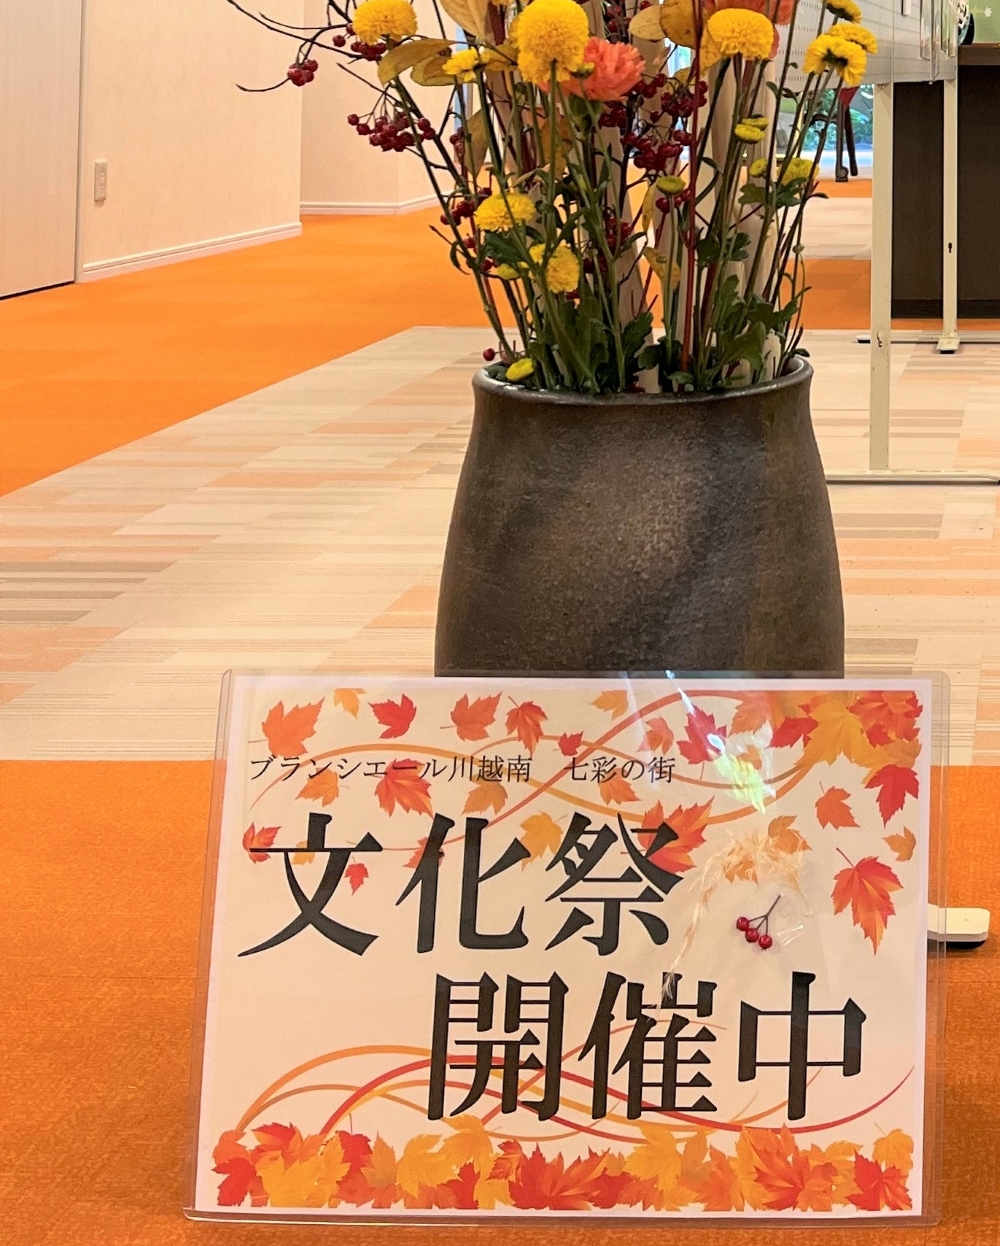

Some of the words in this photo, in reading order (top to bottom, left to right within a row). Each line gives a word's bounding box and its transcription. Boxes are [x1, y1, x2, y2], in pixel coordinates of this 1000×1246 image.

[250, 754, 532, 783] ブランシエール川越南
[565, 755, 676, 784] 七彩の街
[238, 811, 683, 957] 文化祭
[426, 971, 867, 1122] 開催中
